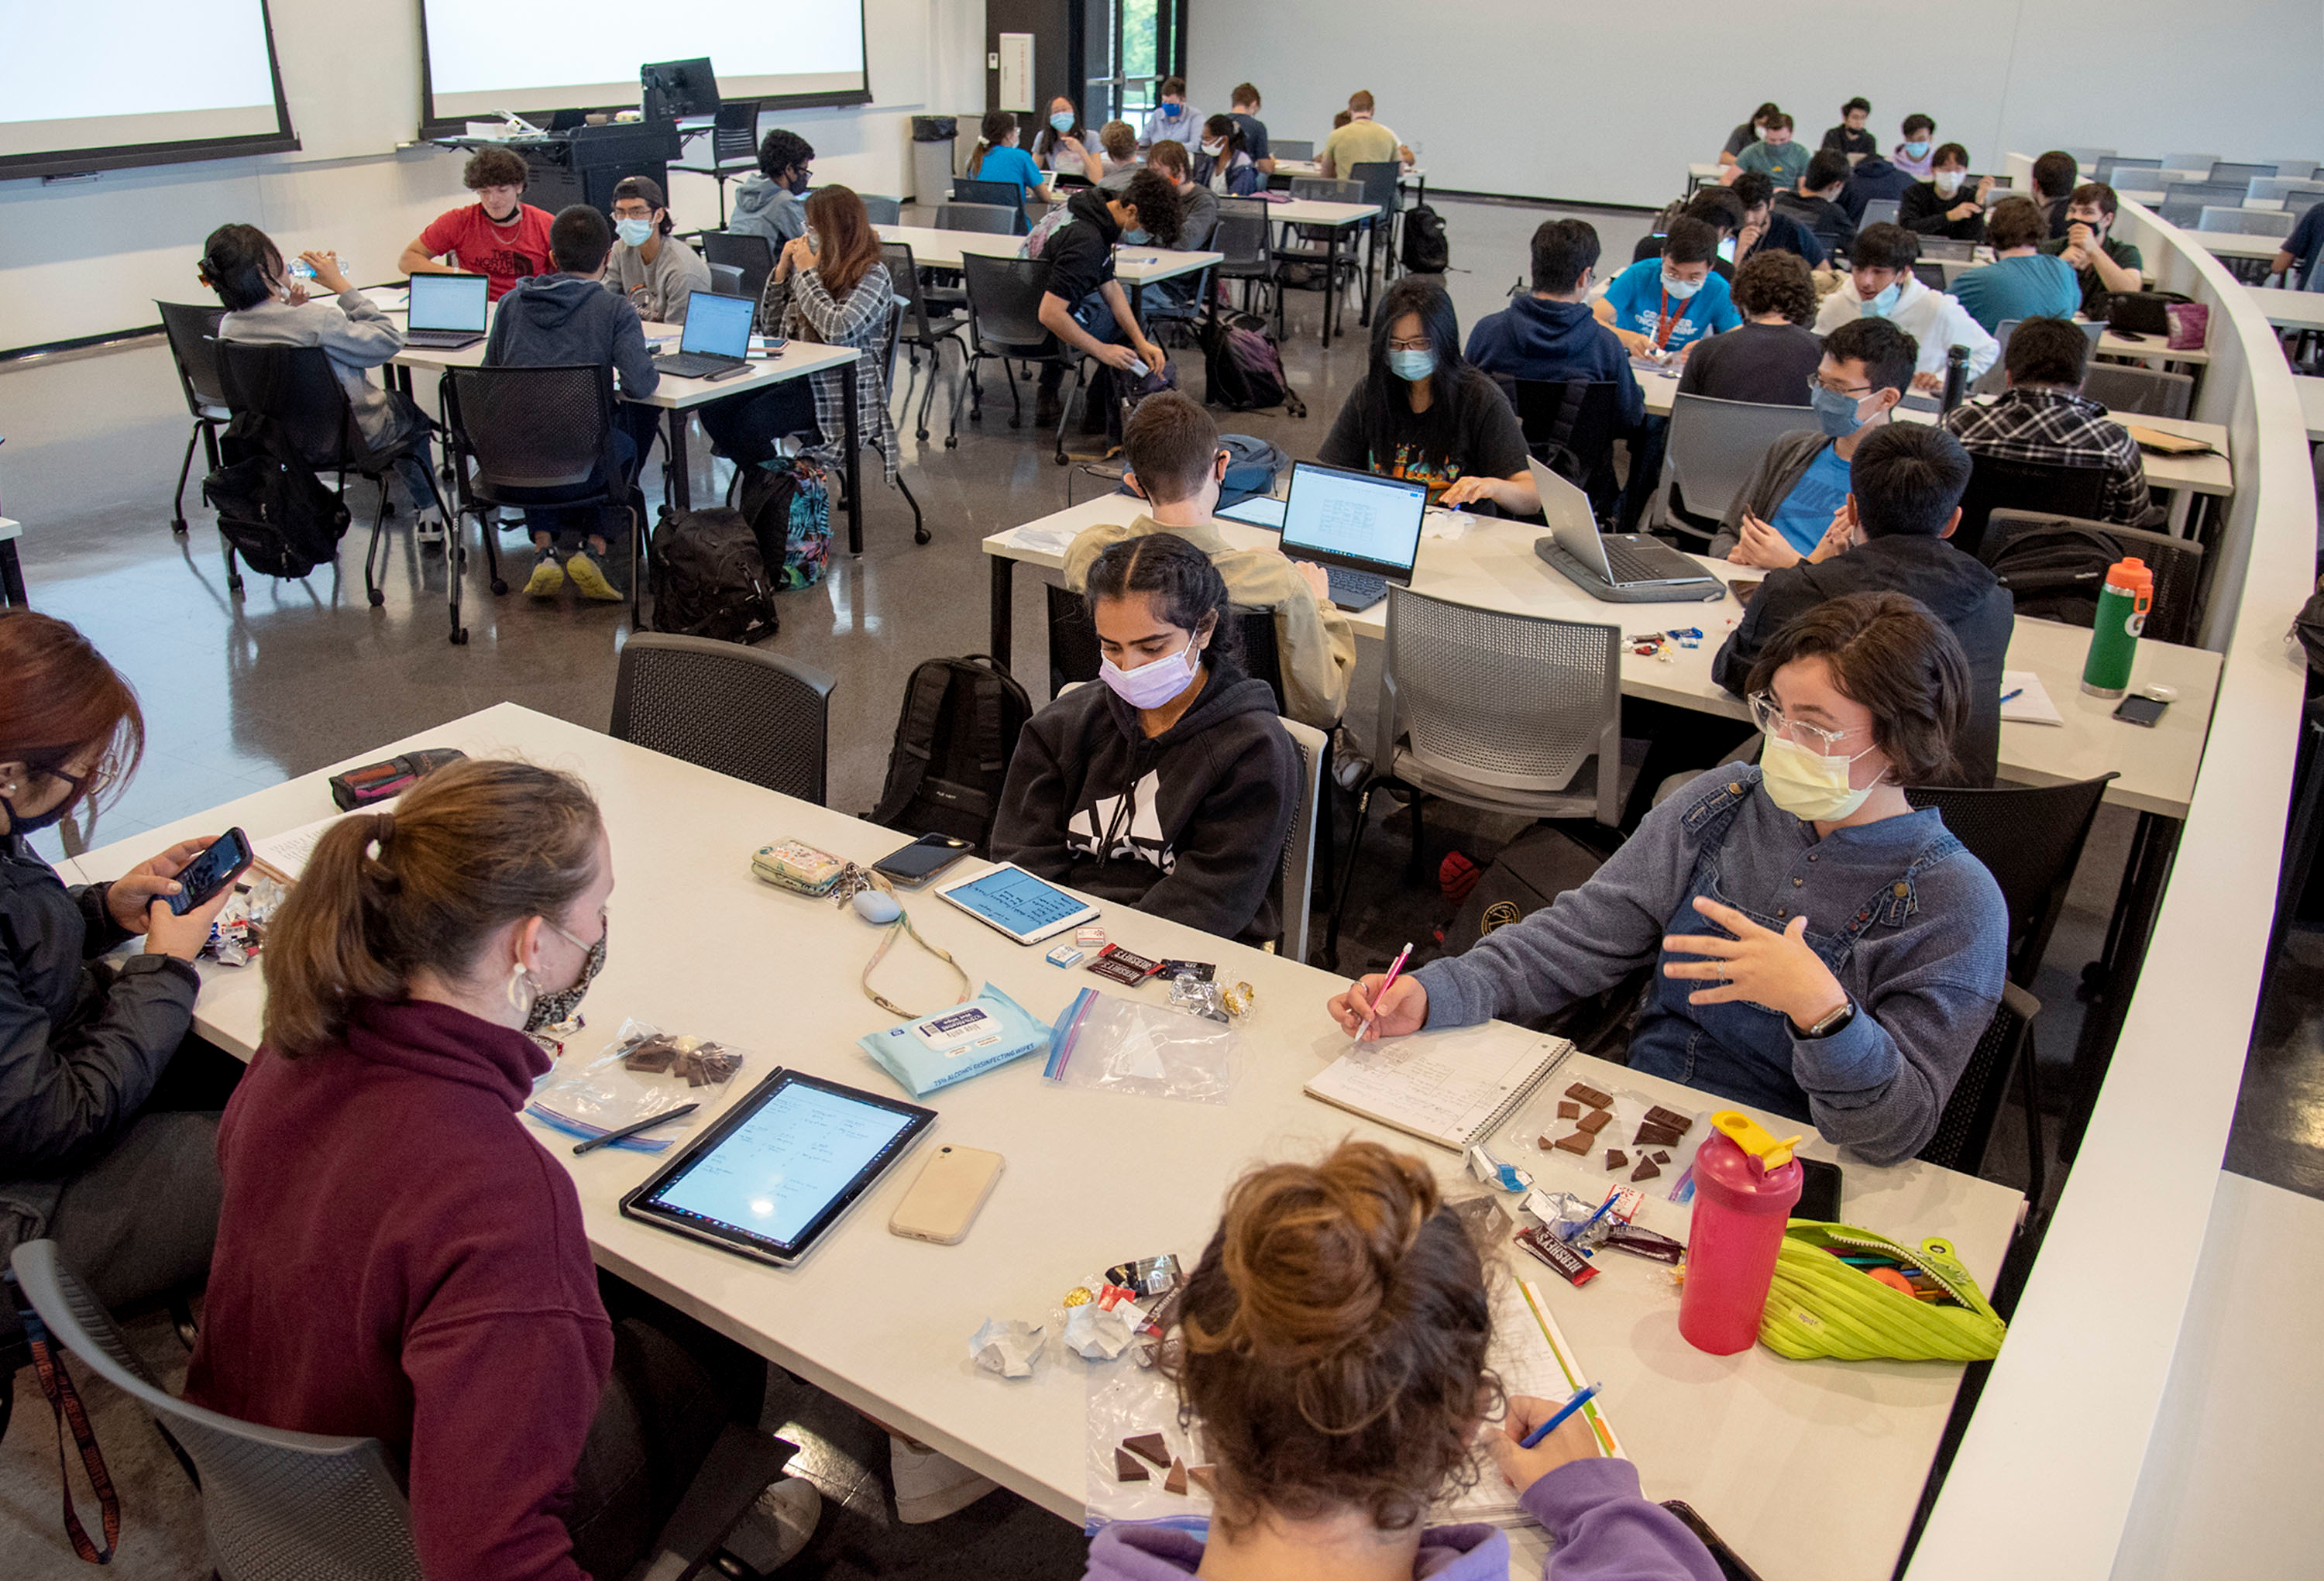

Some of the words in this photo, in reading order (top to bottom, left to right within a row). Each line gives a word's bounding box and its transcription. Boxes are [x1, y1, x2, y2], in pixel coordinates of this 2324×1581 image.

[475, 256, 513, 267] NORTH
[491, 249, 511, 259] THE
[947, 1064, 973, 1081] ALCOHOL
[973, 1050, 1016, 1069] DISINFECTING
[1016, 1043, 1035, 1054] WIPES
[1535, 1232, 1583, 1273] HERSHEY'S
